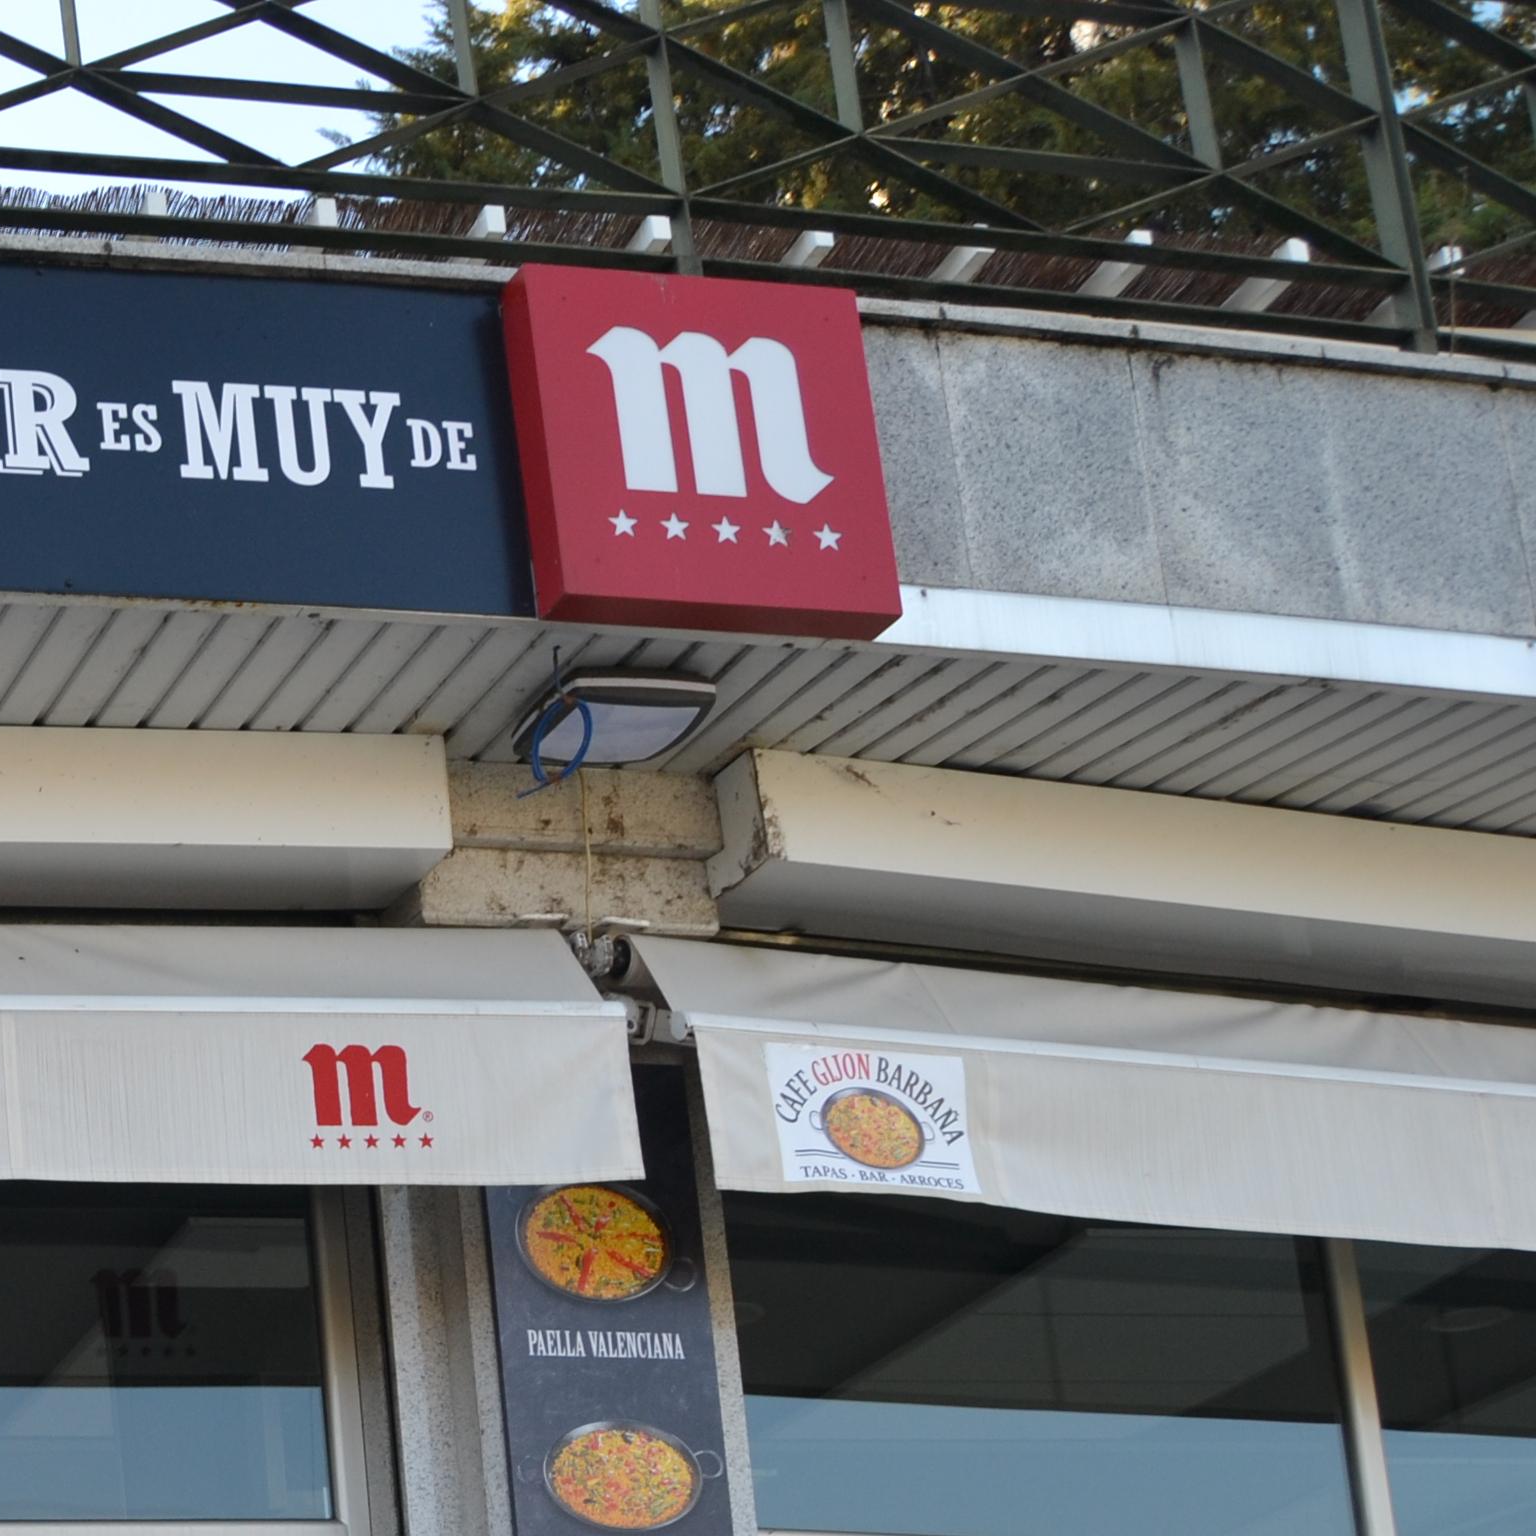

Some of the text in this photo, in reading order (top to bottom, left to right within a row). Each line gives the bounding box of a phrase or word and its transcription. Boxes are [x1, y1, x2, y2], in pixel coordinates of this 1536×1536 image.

[97, 402, 162, 453] ES
[172, 379, 400, 490] MUY
[406, 417, 477, 472] DE
[775, 1053, 964, 1146] CAFE GIJON BARBAÑA
[800, 1165, 964, 1189] TAPAS BAR ARROCES
[527, 1329, 685, 1360] PAELLA VALENCIANA
